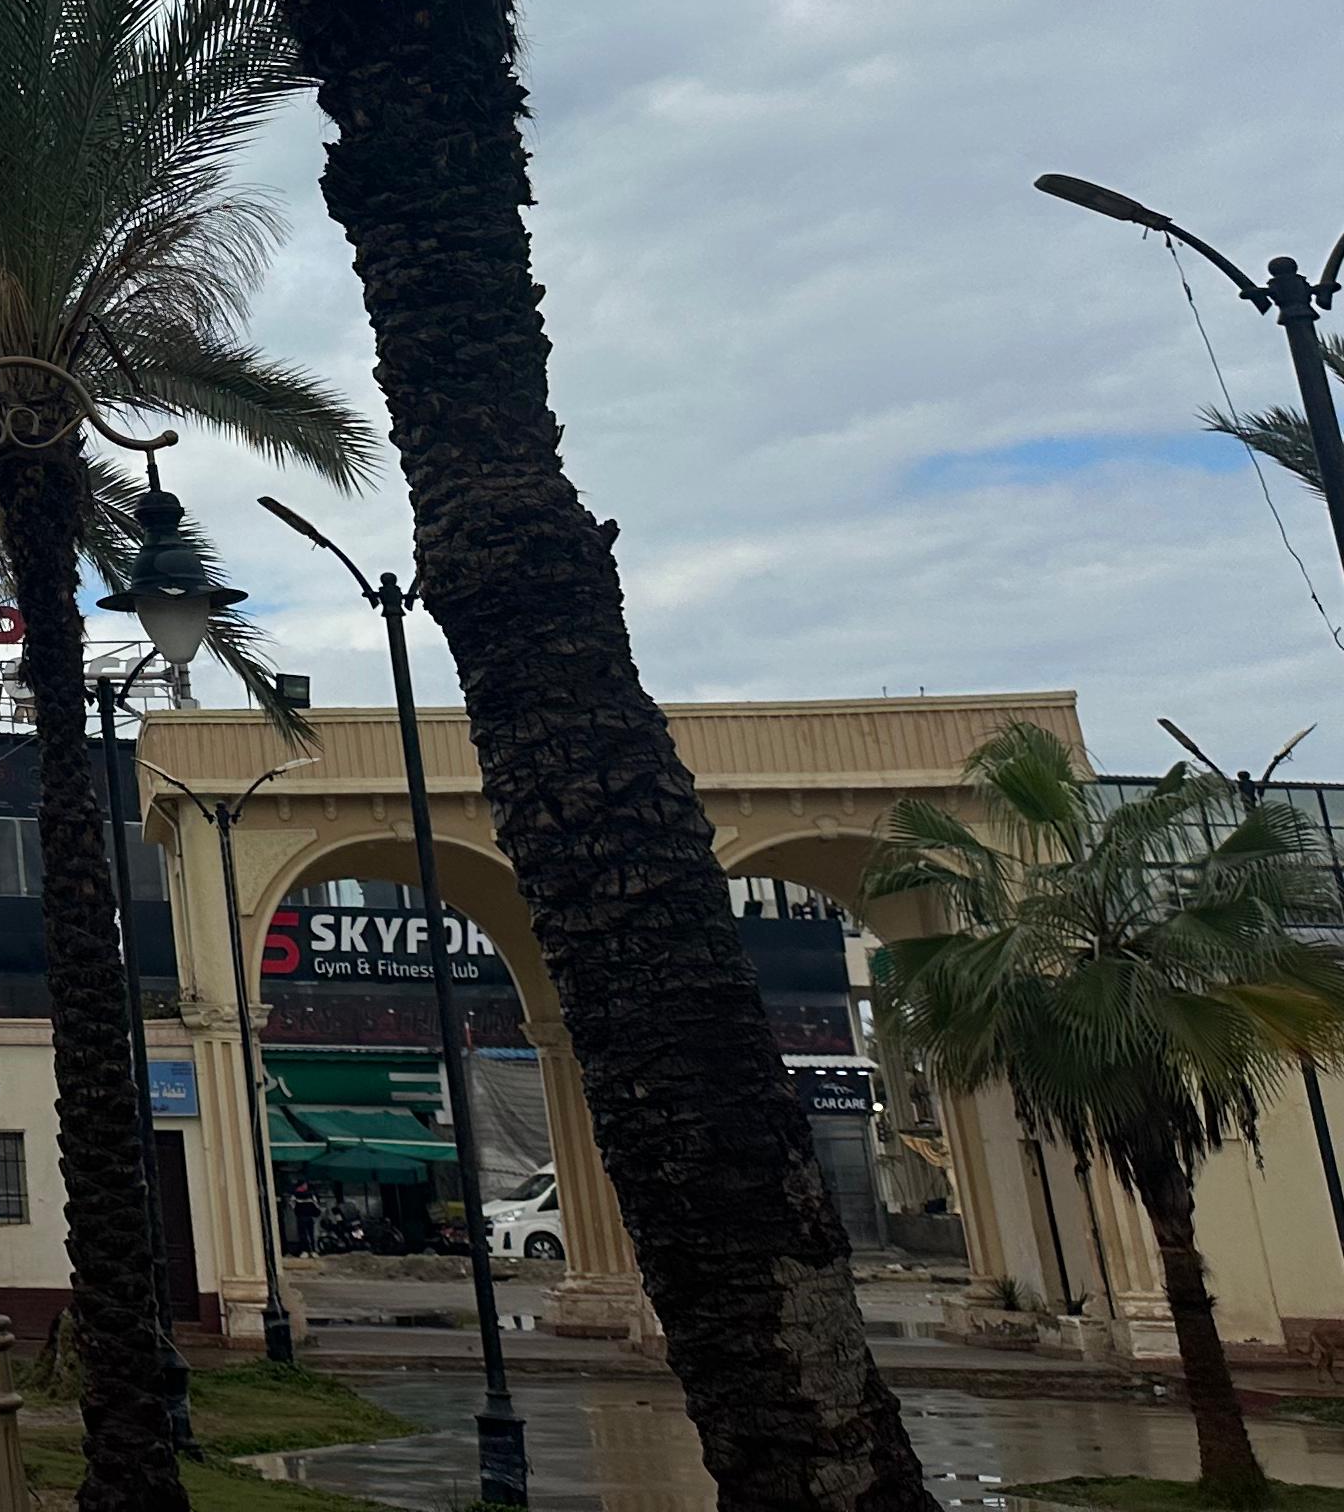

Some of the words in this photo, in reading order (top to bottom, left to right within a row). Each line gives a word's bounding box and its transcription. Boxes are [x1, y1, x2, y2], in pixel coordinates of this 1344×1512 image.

[314, 958, 352, 978] Gym
[357, 959, 371, 975] &
[377, 960, 435, 978] Fitness
[451, 962, 480, 979] lub
[814, 1097, 837, 1109] CAR
[837, 1097, 867, 1110] CARE
